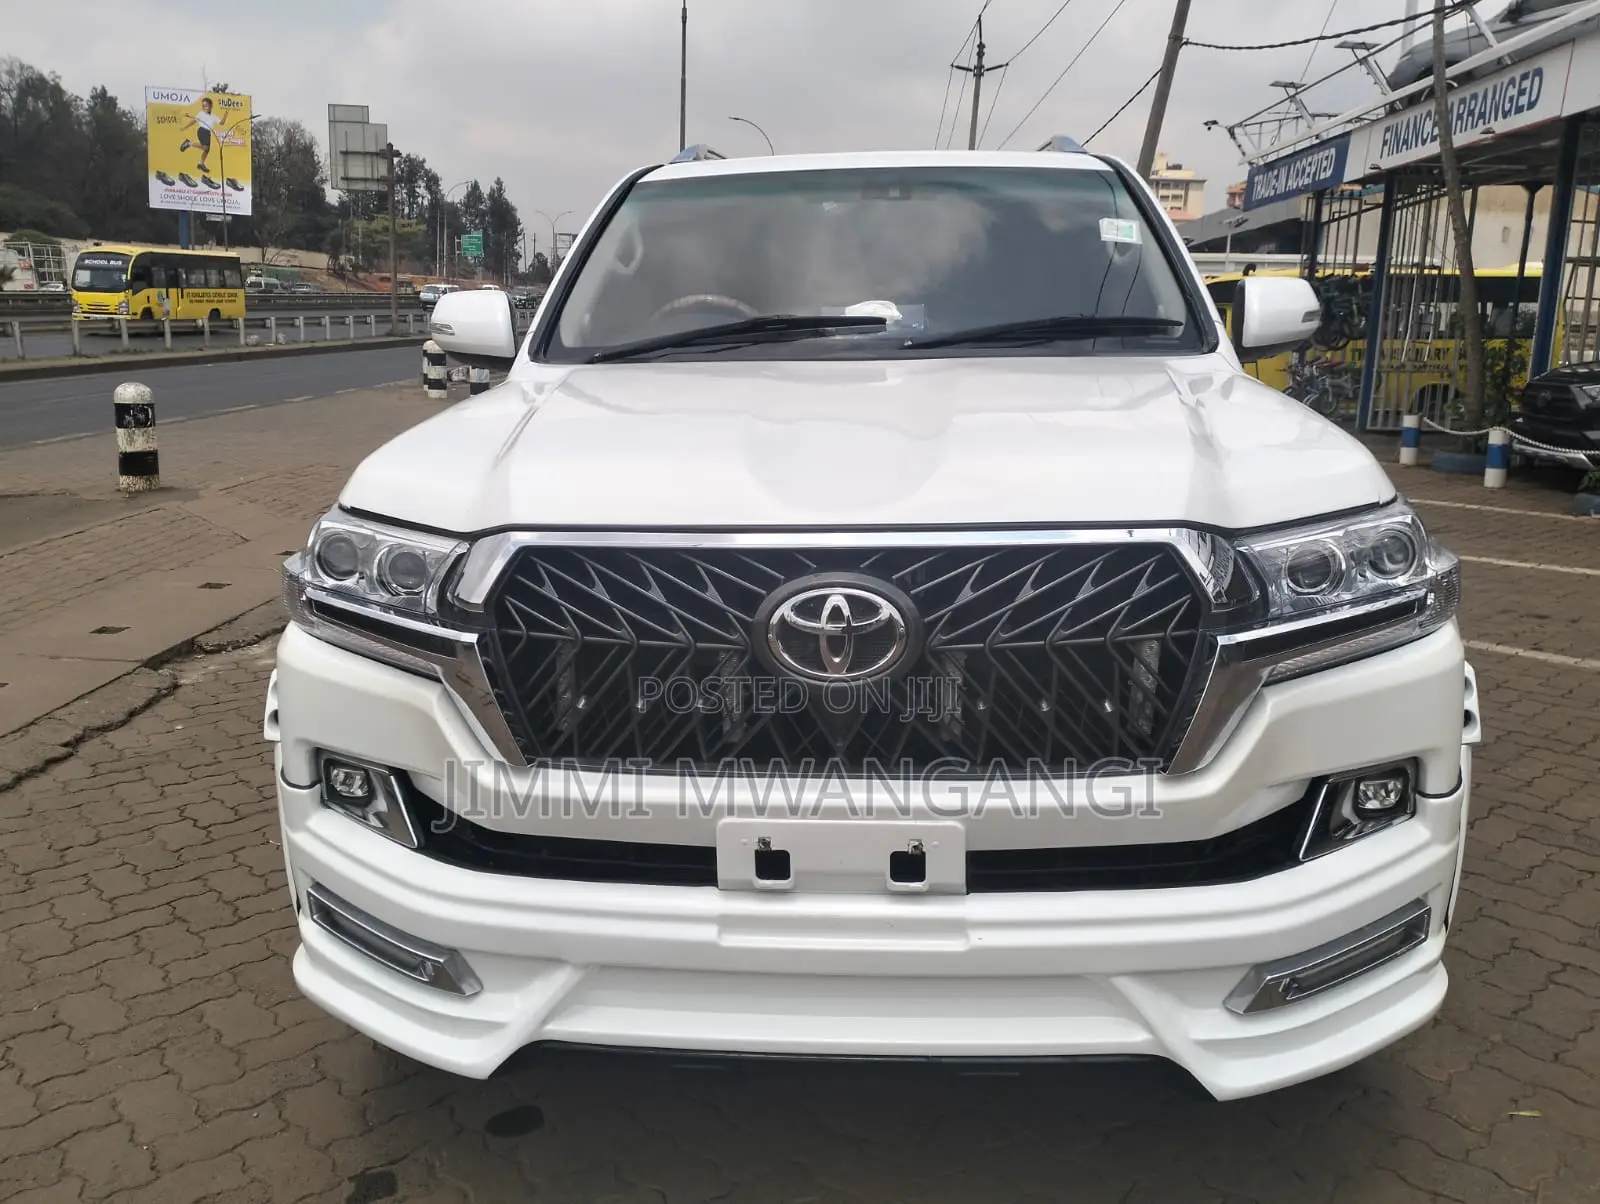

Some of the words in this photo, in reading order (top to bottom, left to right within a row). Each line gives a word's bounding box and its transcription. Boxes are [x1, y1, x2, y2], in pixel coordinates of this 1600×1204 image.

[152, 91, 191, 103] UMOJA
[1379, 110, 1438, 159] FINANCE
[1252, 163, 1288, 202] TRADE-IN
[1286, 147, 1336, 192] ACCEPTED
